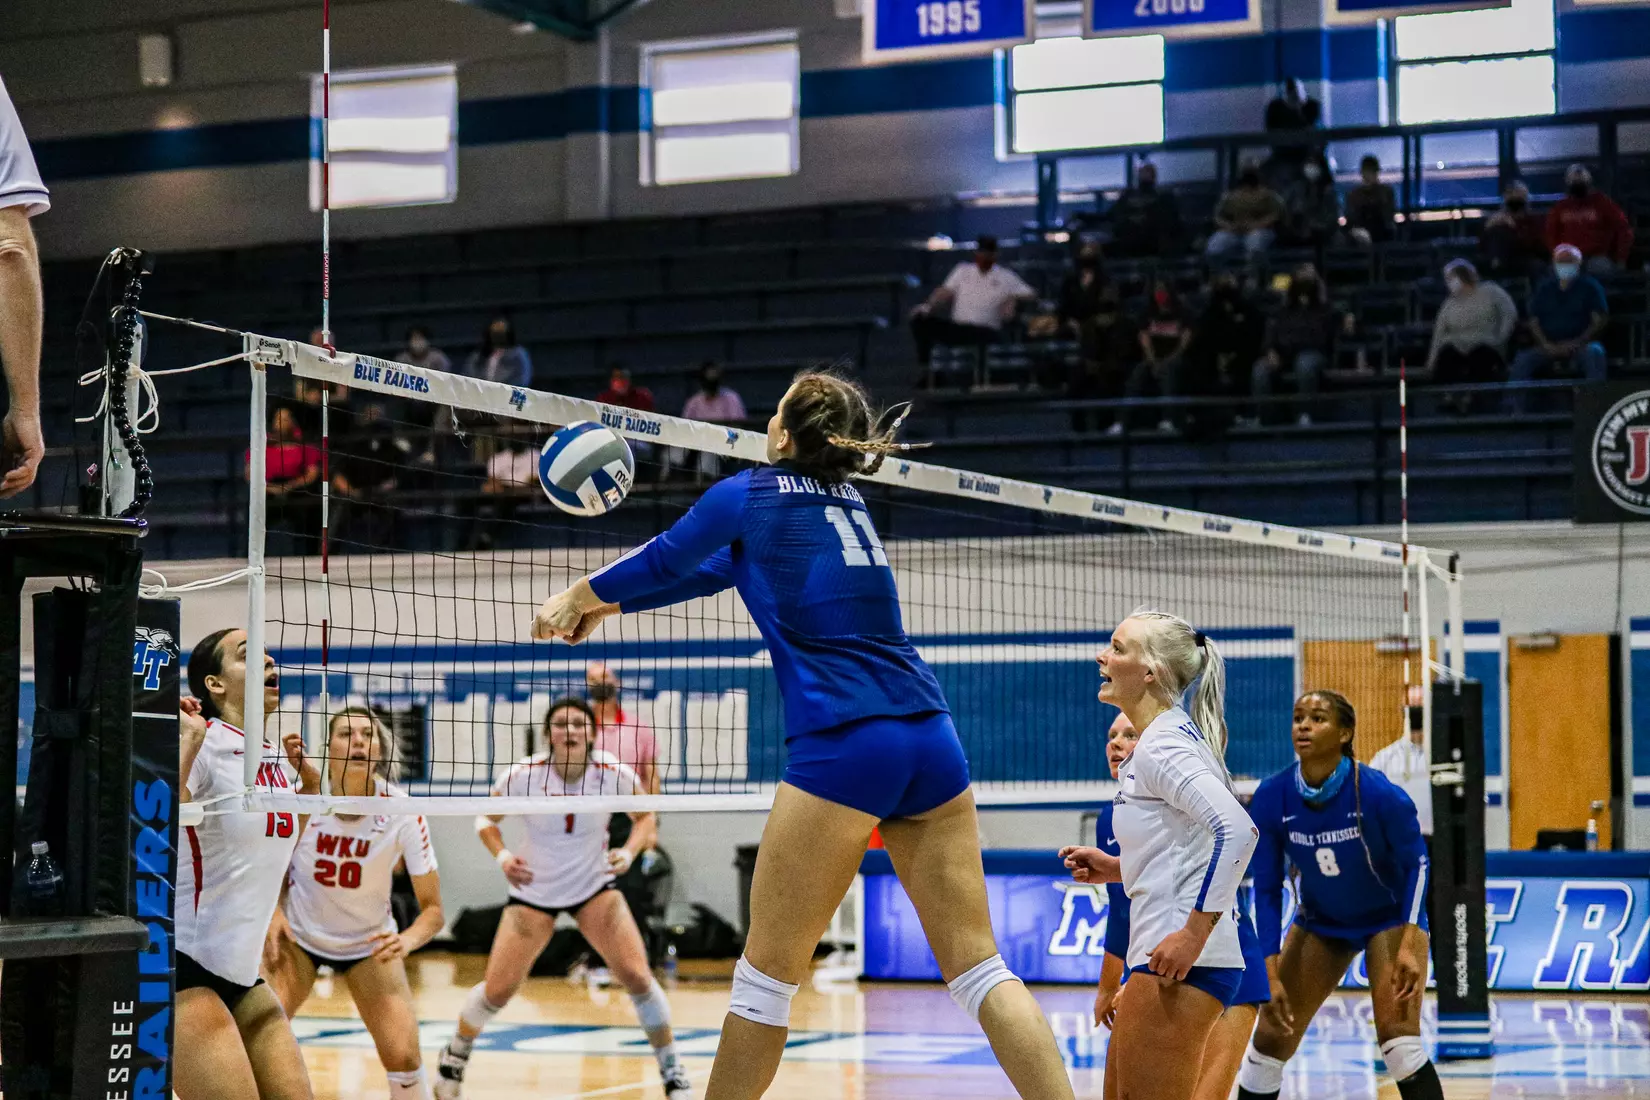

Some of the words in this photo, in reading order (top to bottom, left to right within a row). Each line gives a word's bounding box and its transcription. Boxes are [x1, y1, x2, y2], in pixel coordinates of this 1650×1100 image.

[917, 0, 982, 36] 1995
[264, 340, 281, 348] Senoh
[354, 363, 382, 383] BLUE
[384, 369, 429, 393] RAIDERS
[601, 412, 623, 429] BLUE
[625, 417, 661, 436] RAIDERS
[776, 475, 827, 495] BLUE
[824, 505, 889, 567] 11
[316, 831, 371, 858] WKU
[1288, 830, 1315, 847] MIDDLE
[1316, 826, 1361, 845] TENNESSEE
[313, 858, 362, 889] 20
[1315, 847, 1341, 877] 8
[134, 778, 172, 1100] RAIDERS
